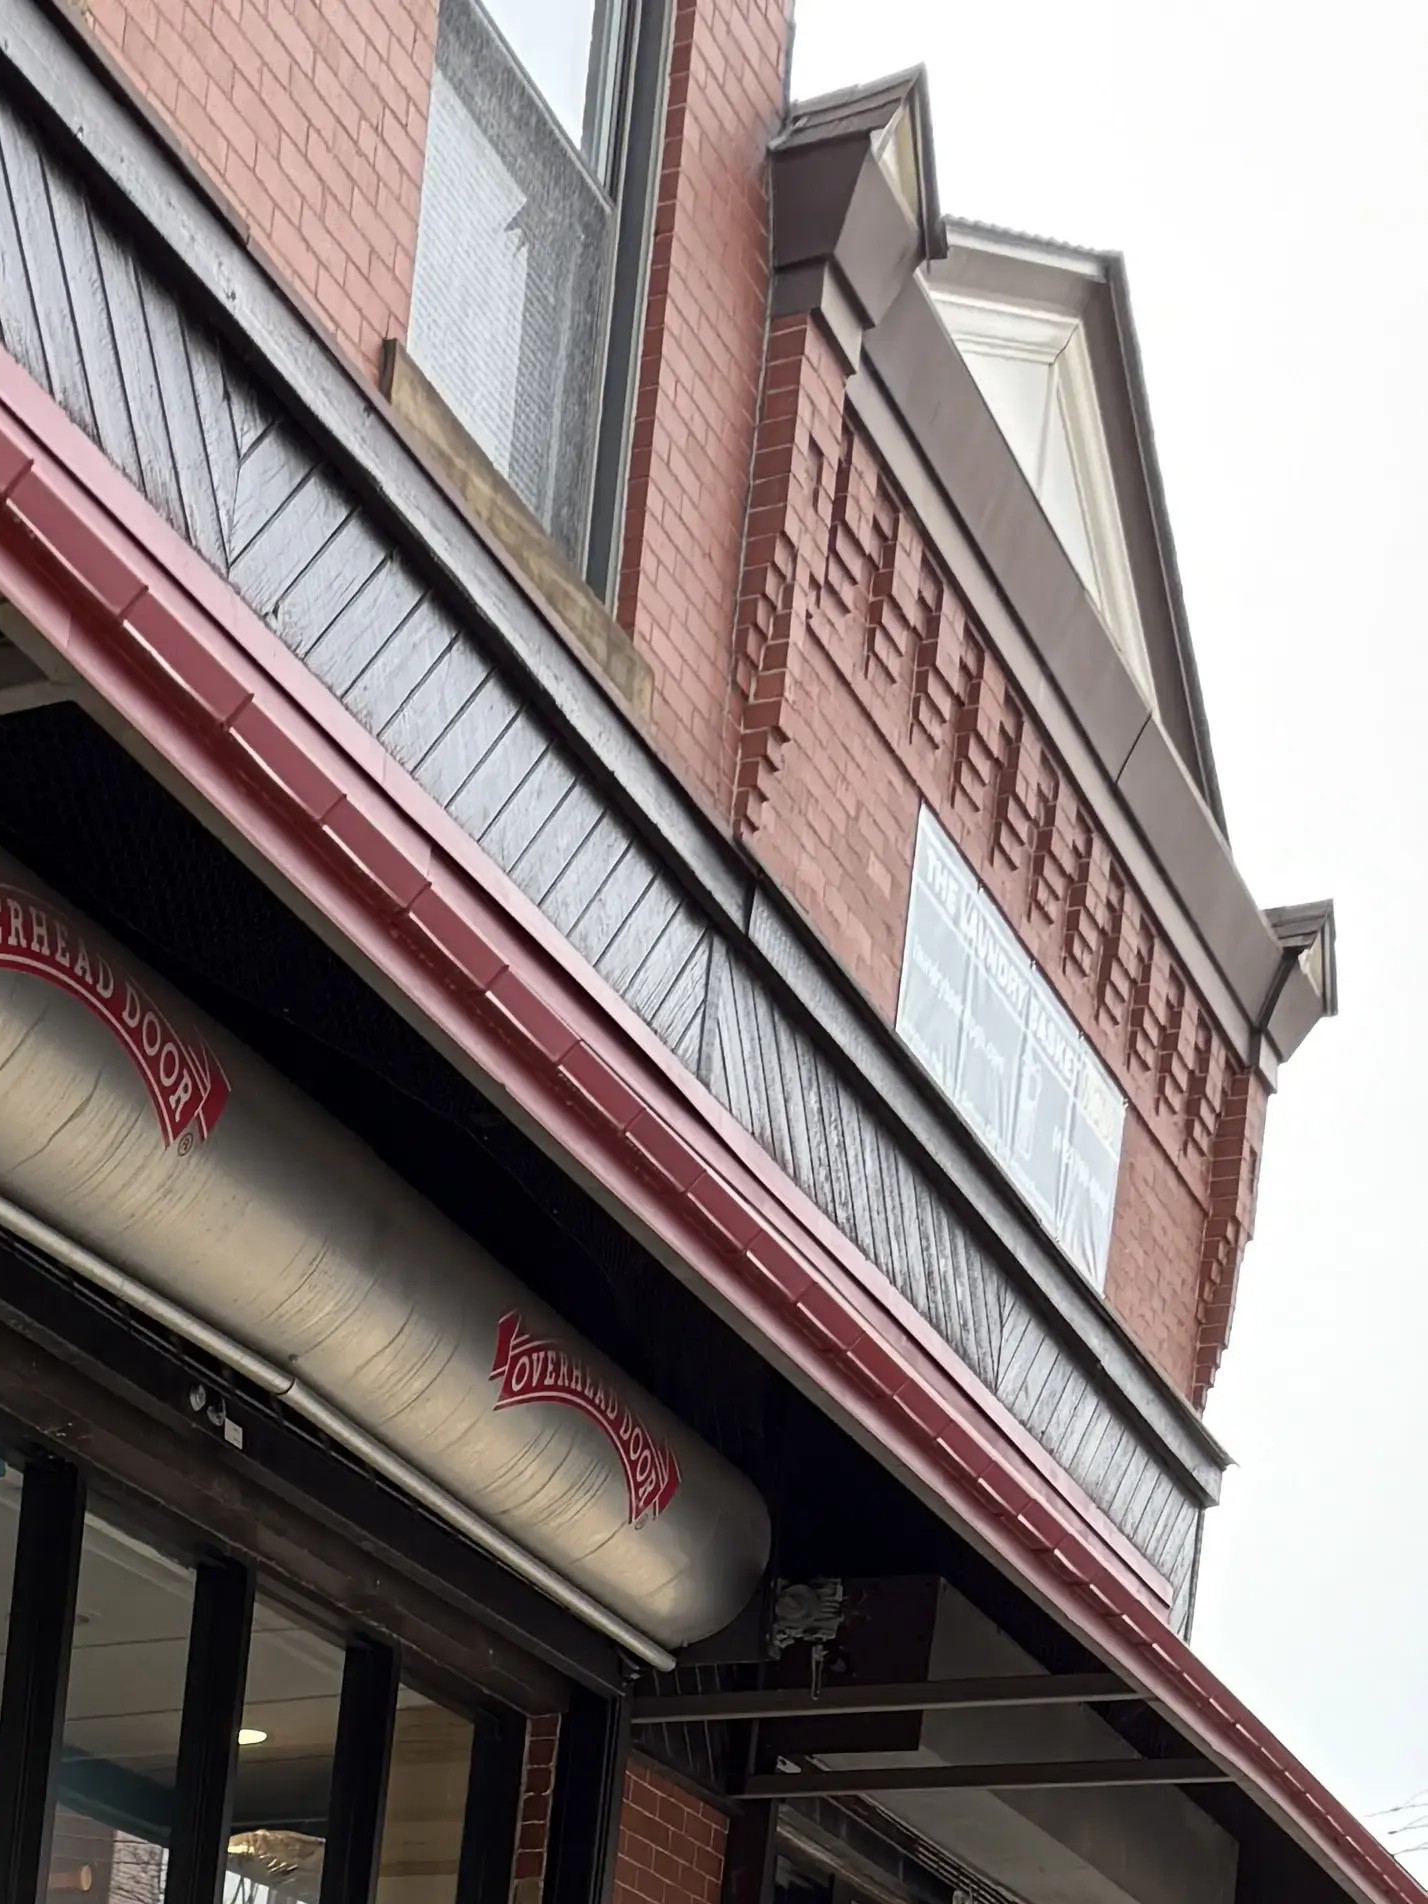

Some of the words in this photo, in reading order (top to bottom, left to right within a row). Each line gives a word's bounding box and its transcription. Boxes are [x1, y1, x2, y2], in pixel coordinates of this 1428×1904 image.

[925, 847, 958, 918] THE
[960, 892, 1029, 1015] LAUNDRY
[122, 979, 193, 1122] DOOR
[512, 1351, 618, 1420] OVERHEAD
[620, 1406, 656, 1507] DOOR
